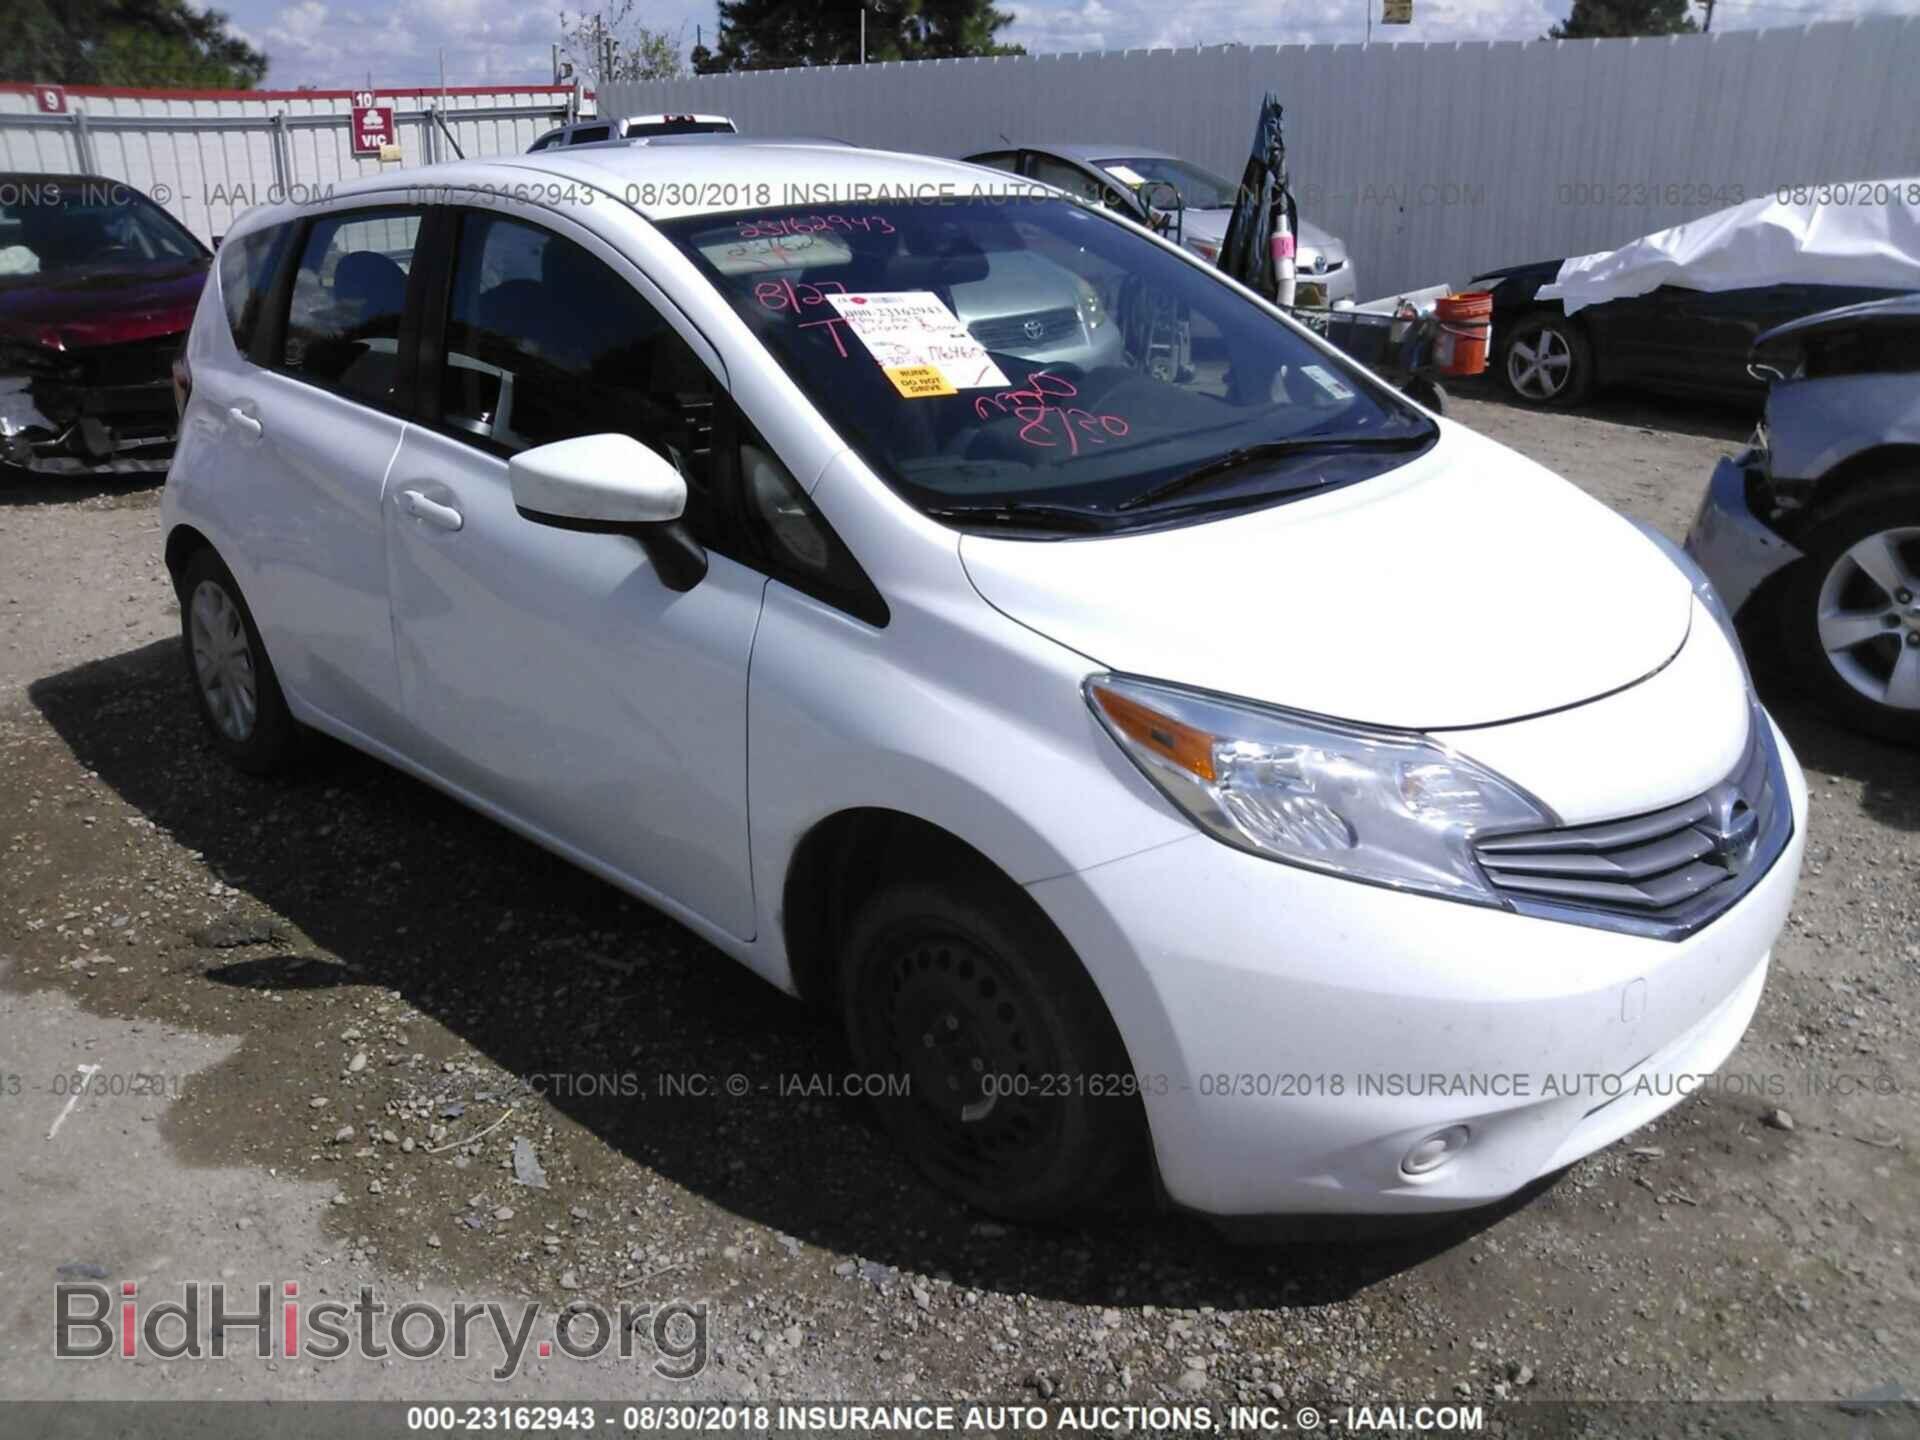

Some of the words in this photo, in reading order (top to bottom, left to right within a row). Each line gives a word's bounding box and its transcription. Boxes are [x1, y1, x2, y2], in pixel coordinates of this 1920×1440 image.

[44, 90, 59, 110] 9
[356, 92, 372, 107] 10
[361, 134, 387, 147] VIC
[736, 214, 896, 238] 23162943
